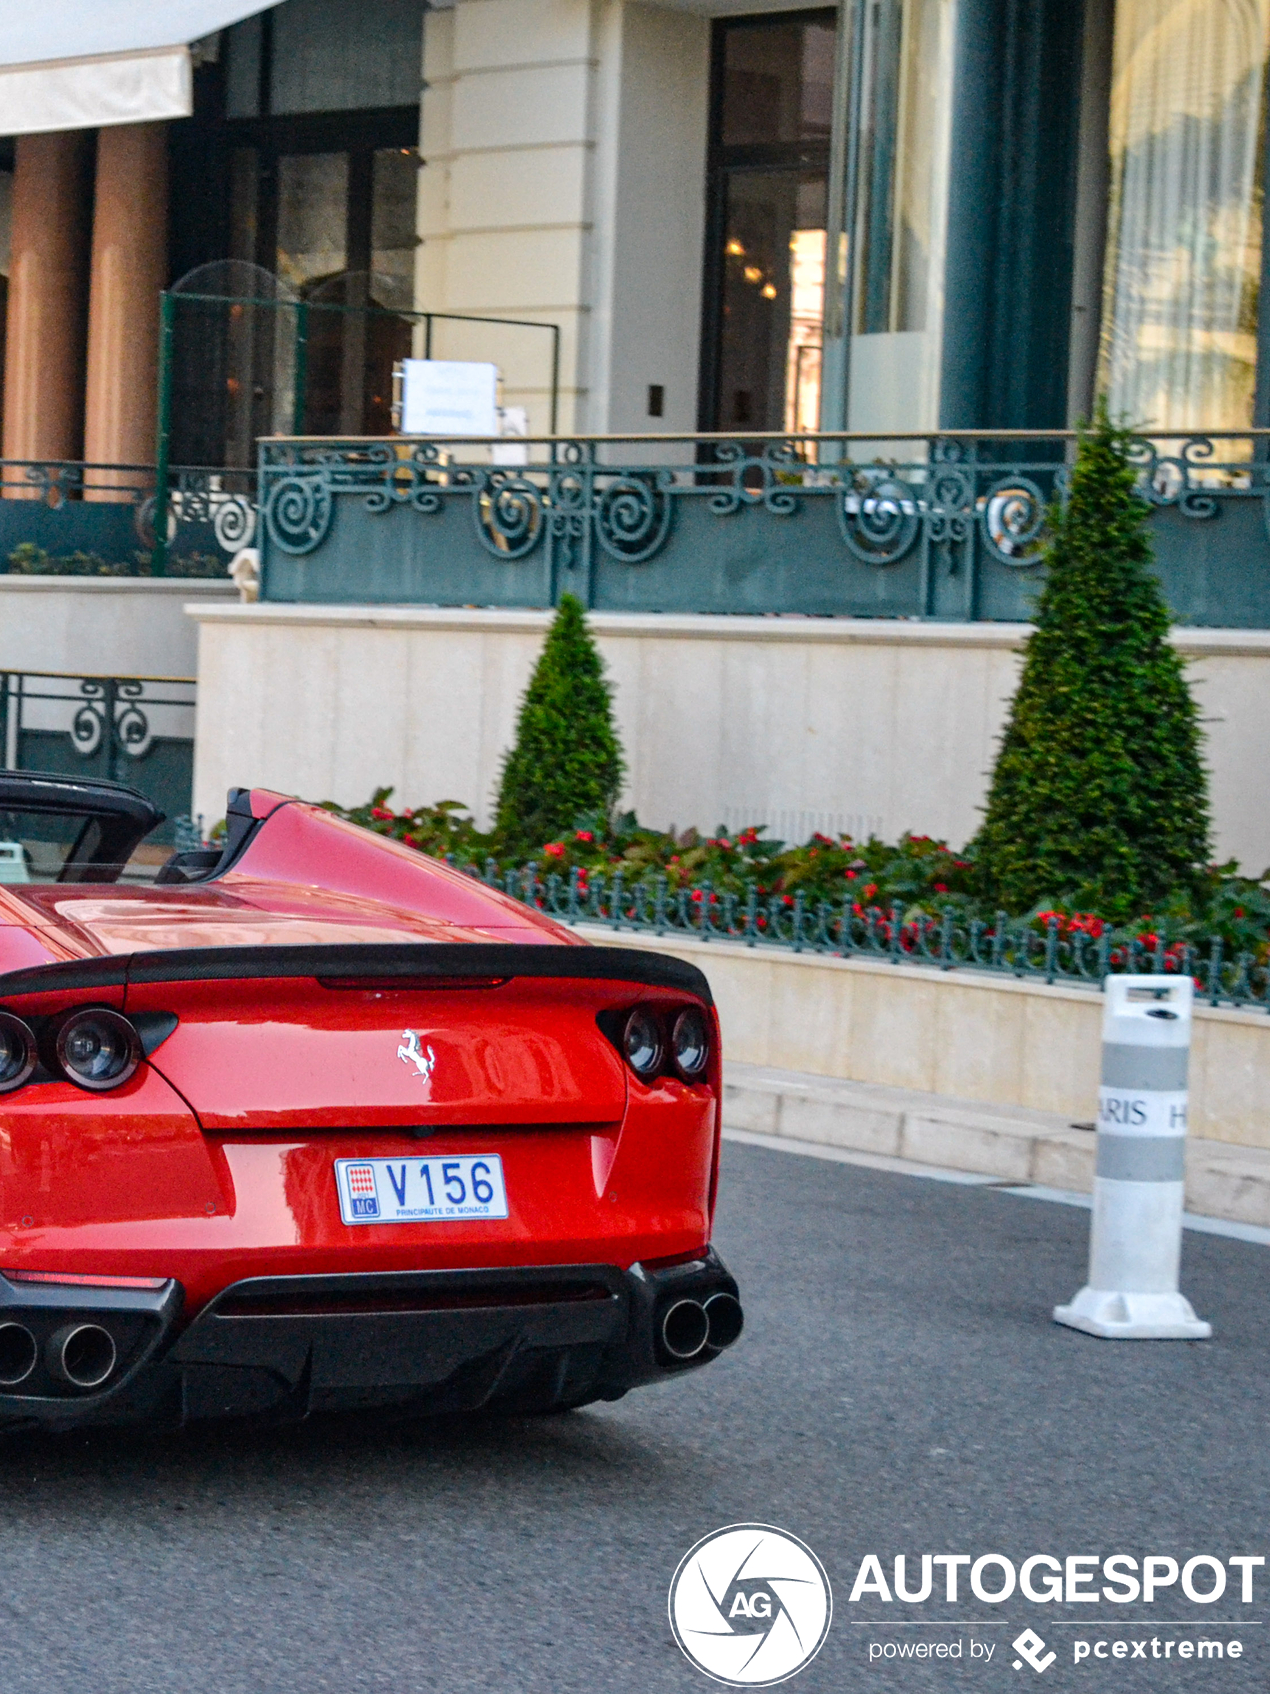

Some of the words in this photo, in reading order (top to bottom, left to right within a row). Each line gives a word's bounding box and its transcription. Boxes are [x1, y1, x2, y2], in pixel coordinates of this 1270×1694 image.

[386, 1161, 494, 1206] V156
[356, 1200, 374, 1214] MC
[445, 1206, 456, 1215] DE
[457, 1206, 490, 1214] MONACO
